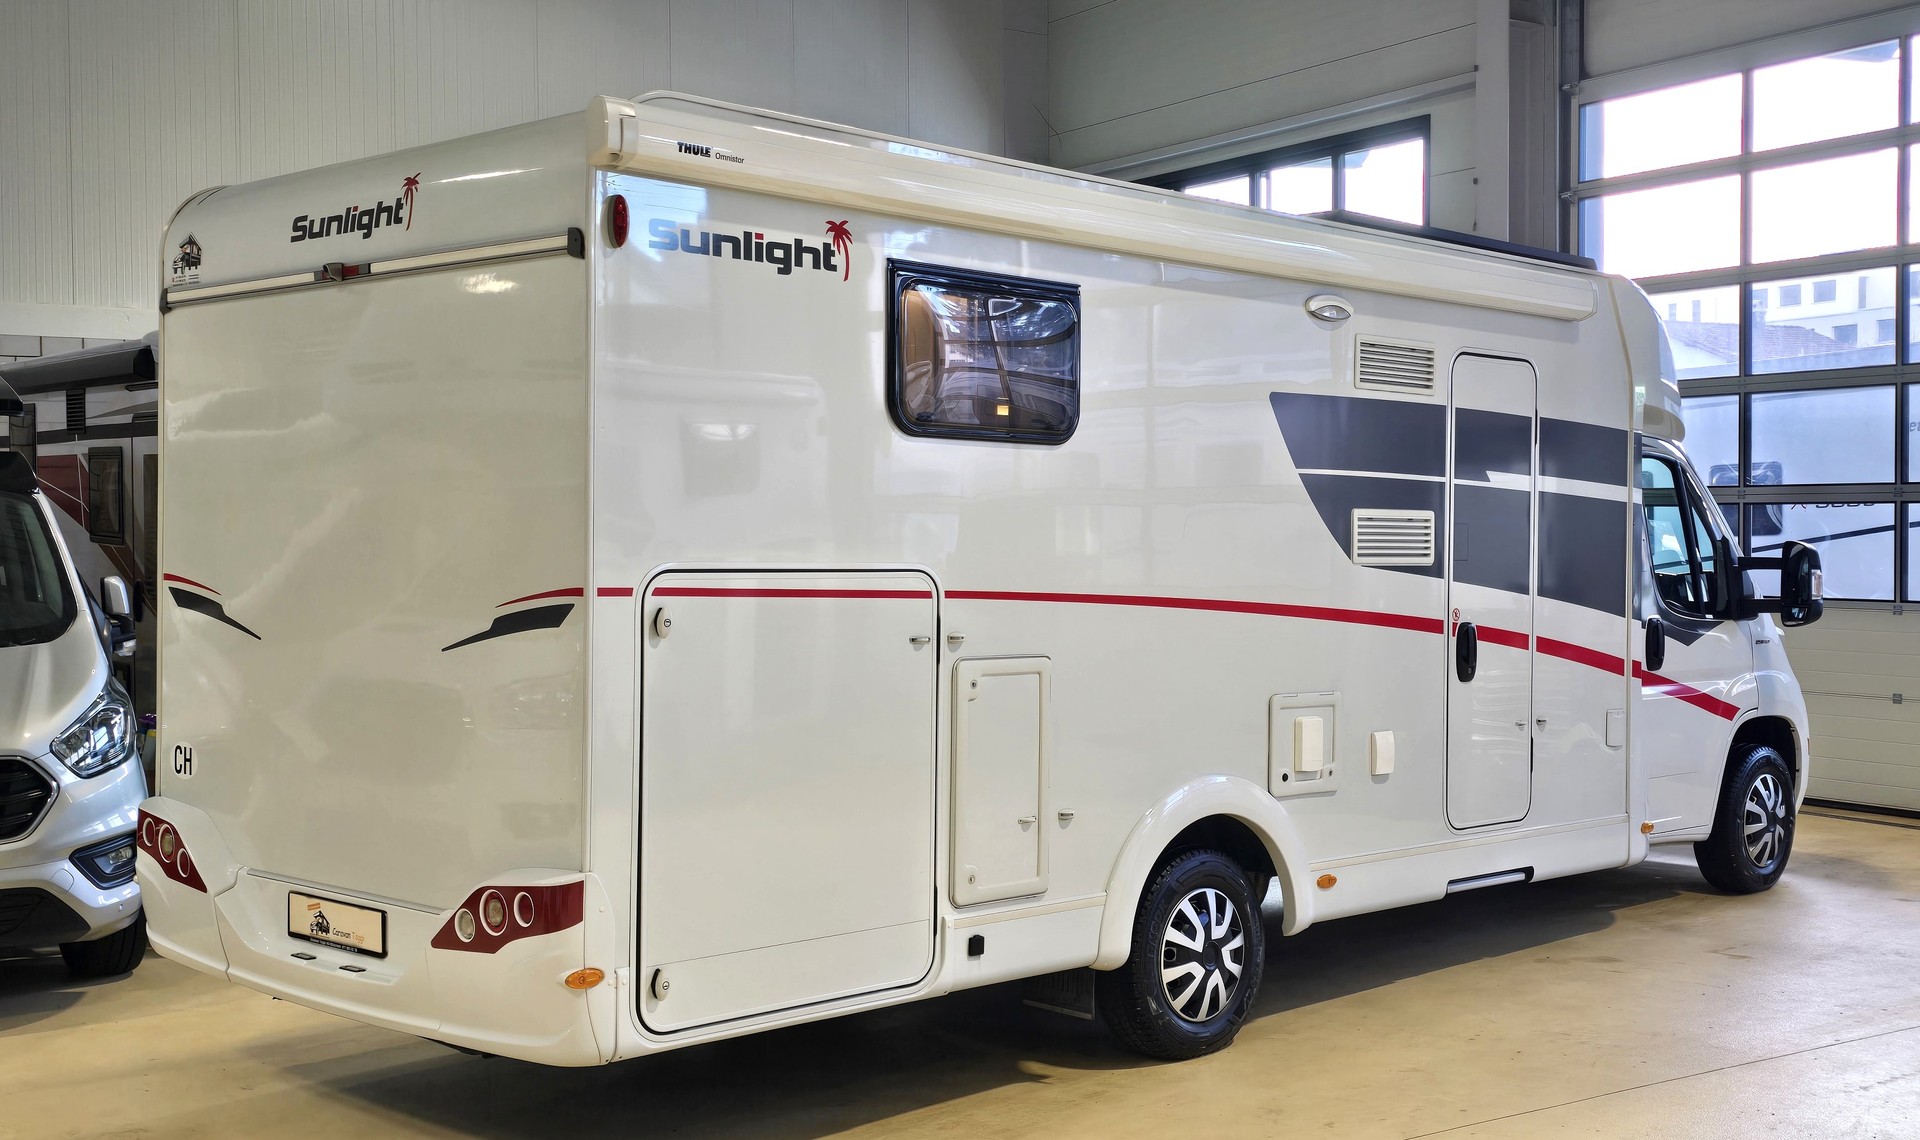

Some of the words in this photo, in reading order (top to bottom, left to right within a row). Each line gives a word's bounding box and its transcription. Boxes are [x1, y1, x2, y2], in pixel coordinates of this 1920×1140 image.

[677, 141, 711, 158] THULE
[715, 152, 745, 164] Omnistor
[290, 197, 404, 243] Sunlight
[648, 217, 838, 276] Sunlight
[174, 744, 192, 776] CH
